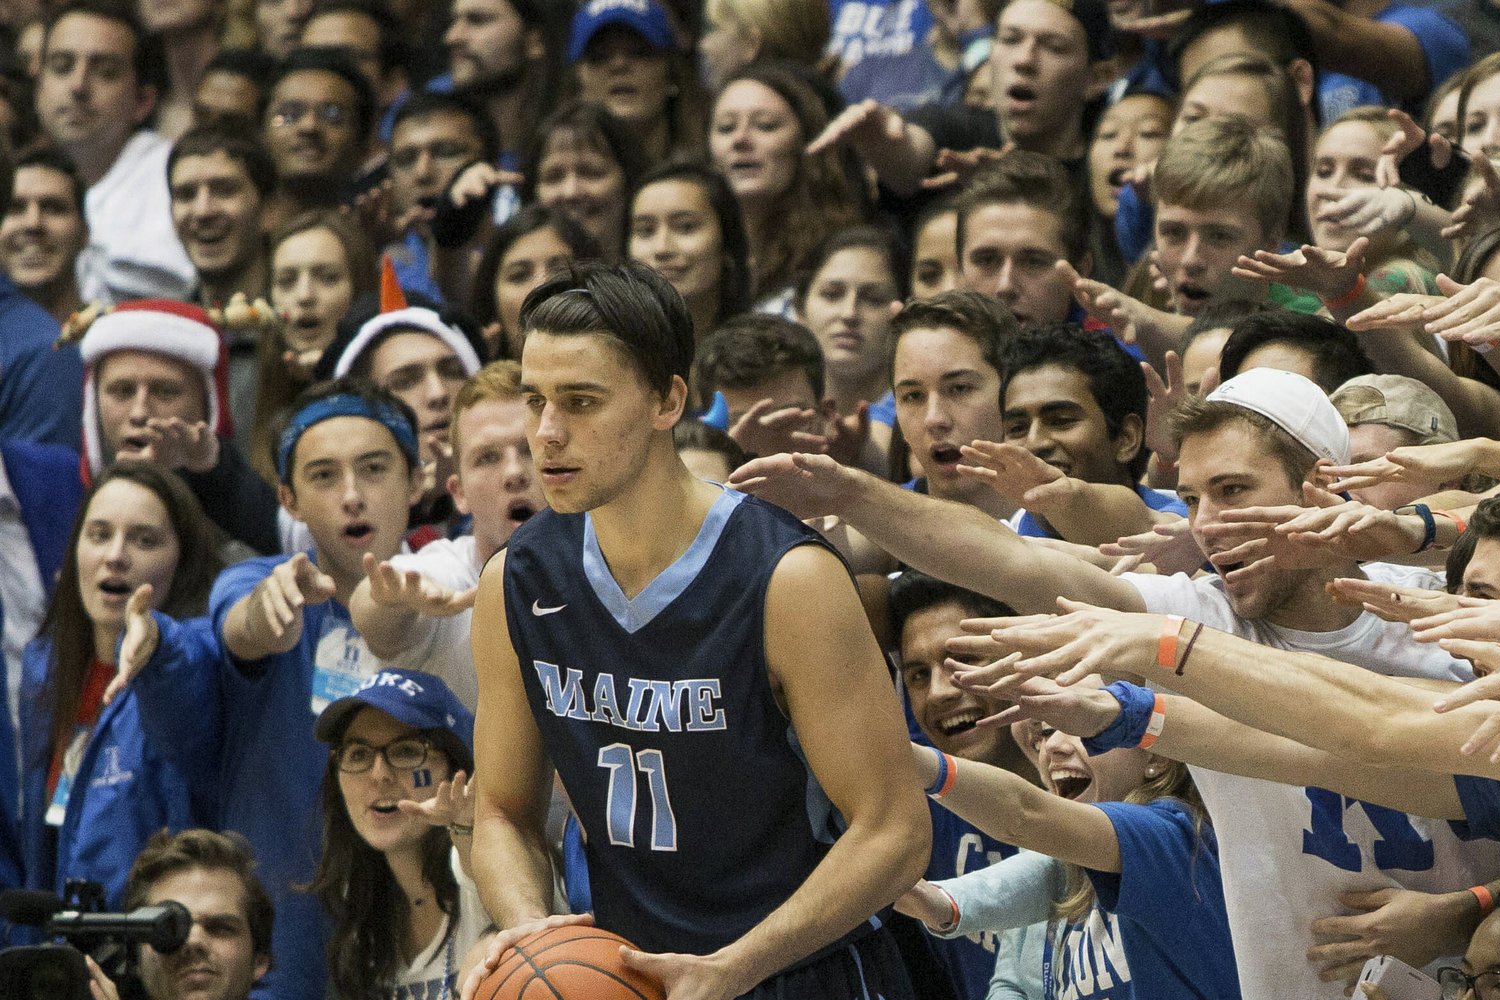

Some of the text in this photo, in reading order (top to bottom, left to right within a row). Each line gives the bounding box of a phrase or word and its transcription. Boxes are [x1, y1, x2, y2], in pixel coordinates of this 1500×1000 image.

[351, 671, 425, 697] UKE
[533, 660, 727, 732] MAINE
[597, 742, 678, 851] 11
